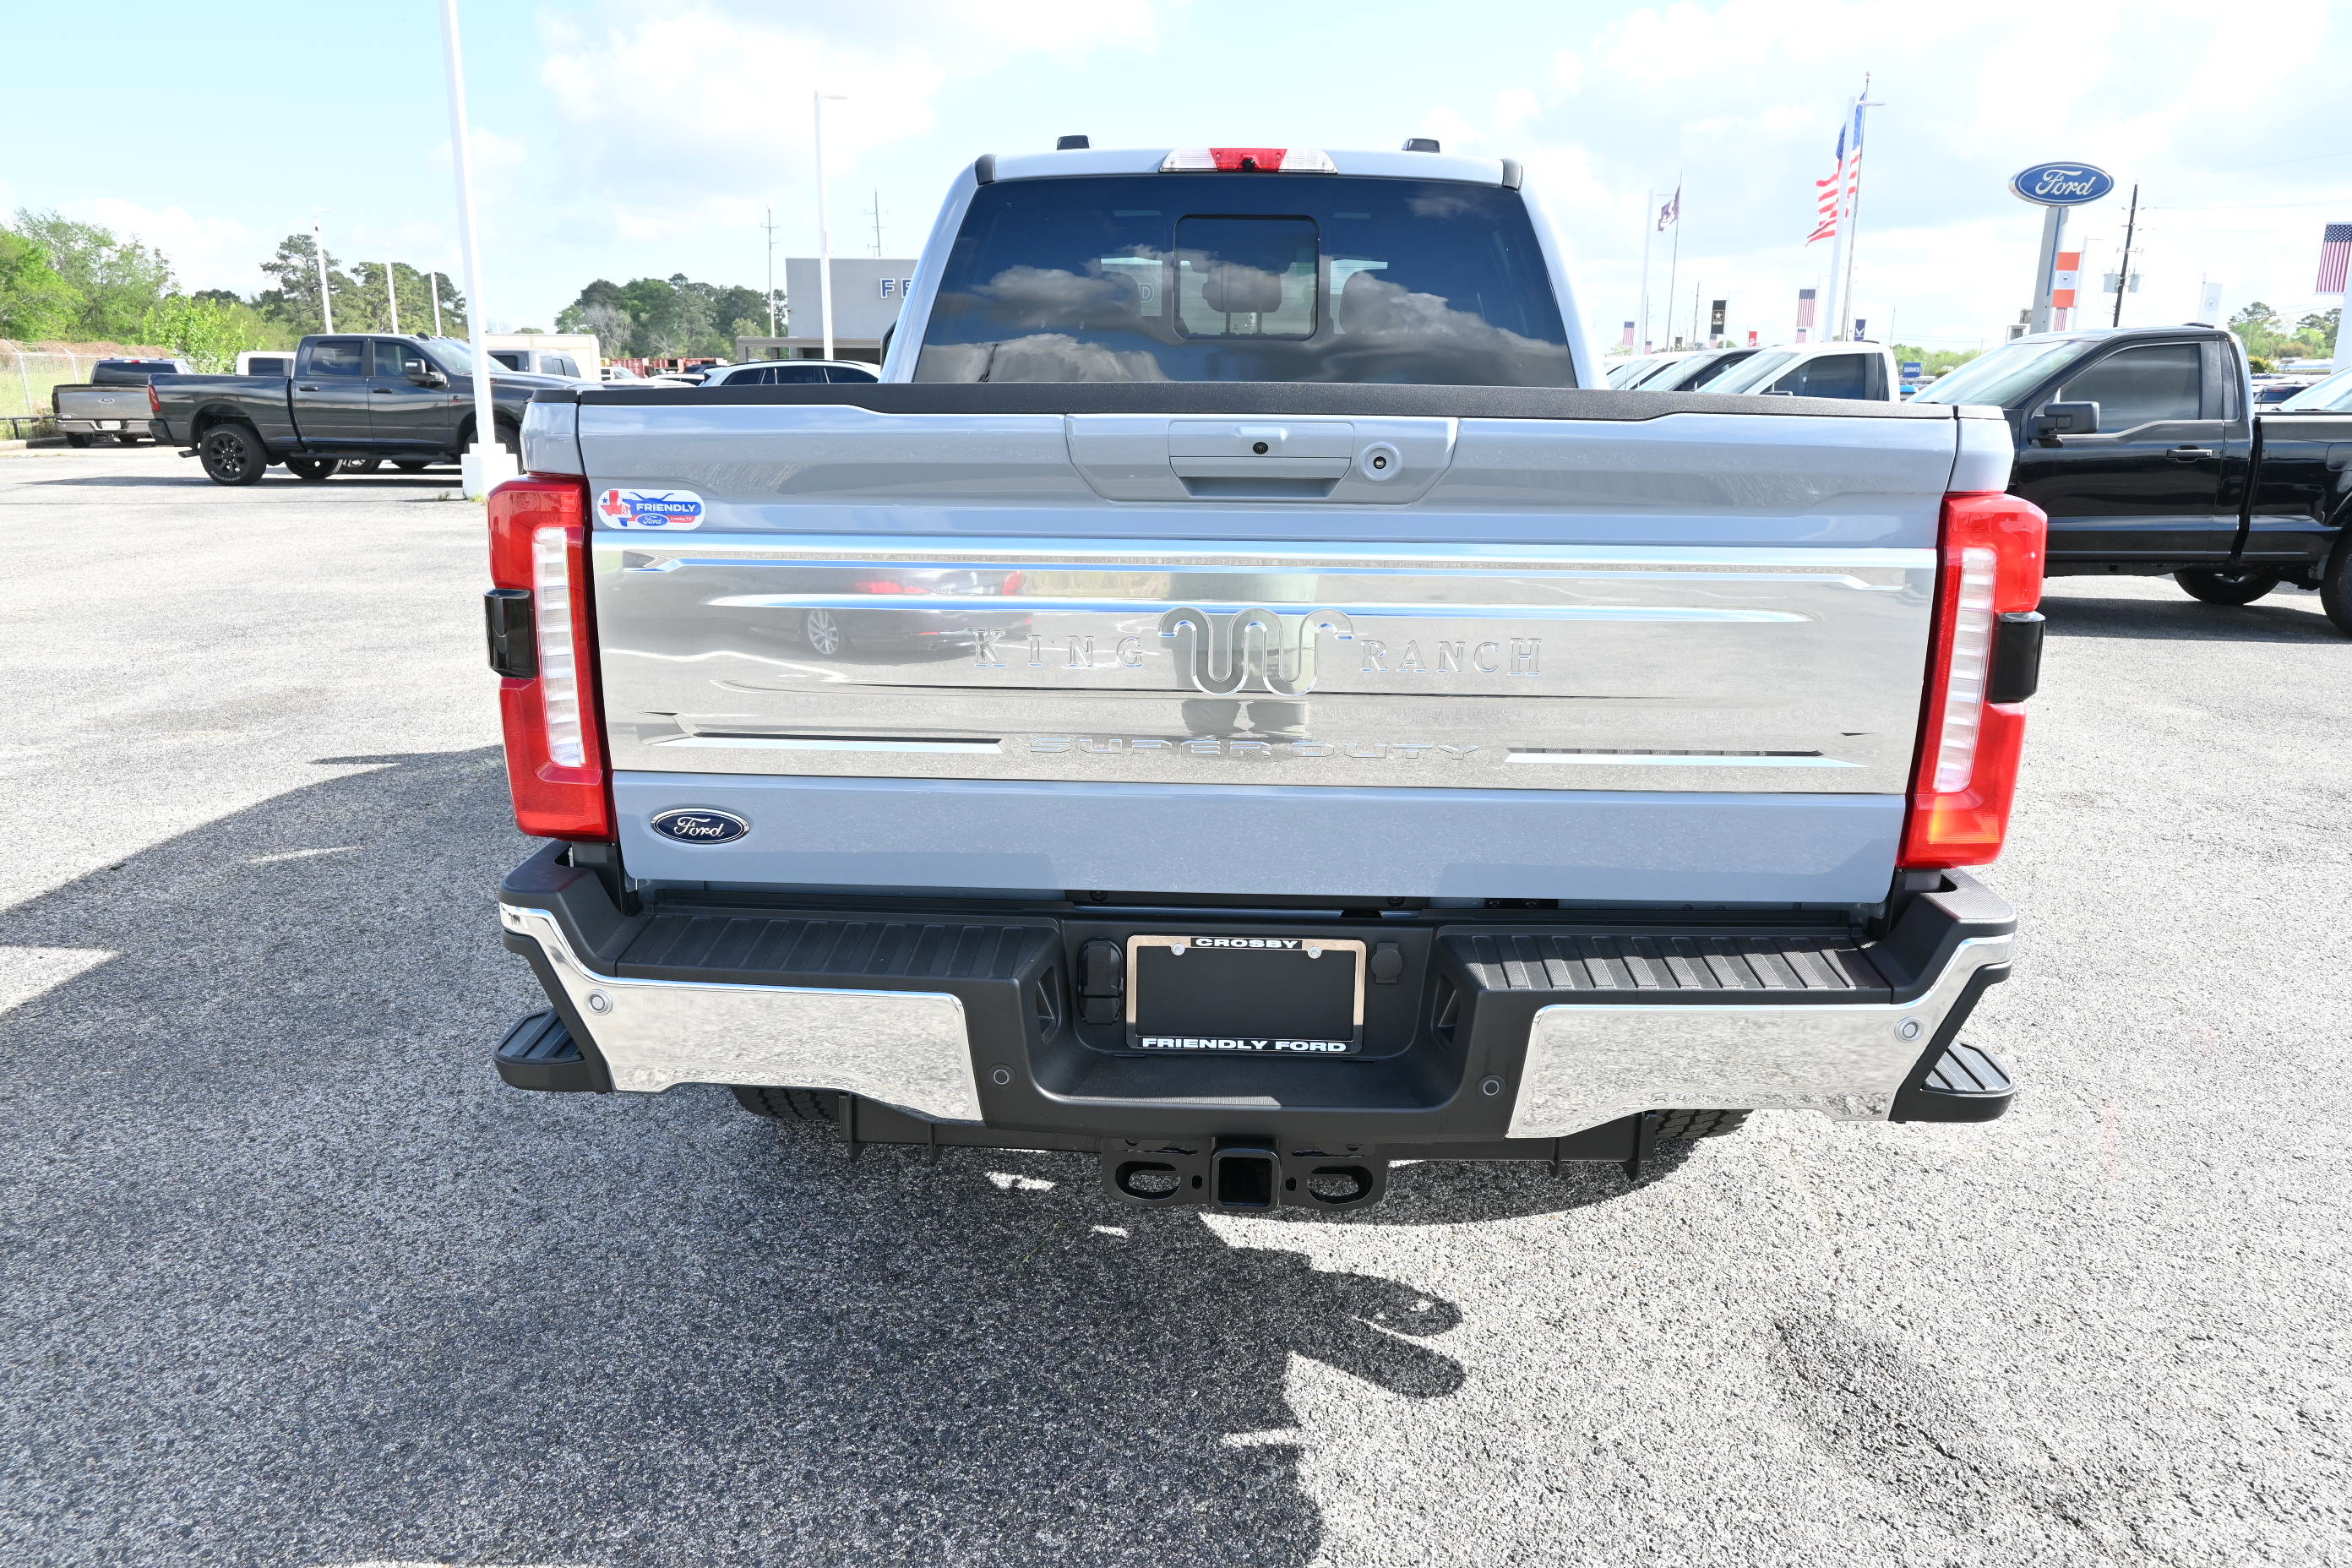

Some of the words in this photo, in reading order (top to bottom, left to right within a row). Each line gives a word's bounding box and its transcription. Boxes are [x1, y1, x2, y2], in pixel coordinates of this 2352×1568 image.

[2035, 169, 2097, 195] Ford
[636, 503, 695, 512] FRIENDLY
[642, 515, 662, 525] Ford
[973, 629, 1143, 667] KING
[1359, 636, 1543, 676] RANCH
[1030, 738, 1271, 757] SUPER
[1292, 742, 1478, 760] DUTY
[673, 816, 725, 837] Ford
[1195, 938, 1298, 949] CROSBY
[1142, 1037, 1267, 1050] FRIENDLY
[1275, 1041, 1347, 1052] FORD
